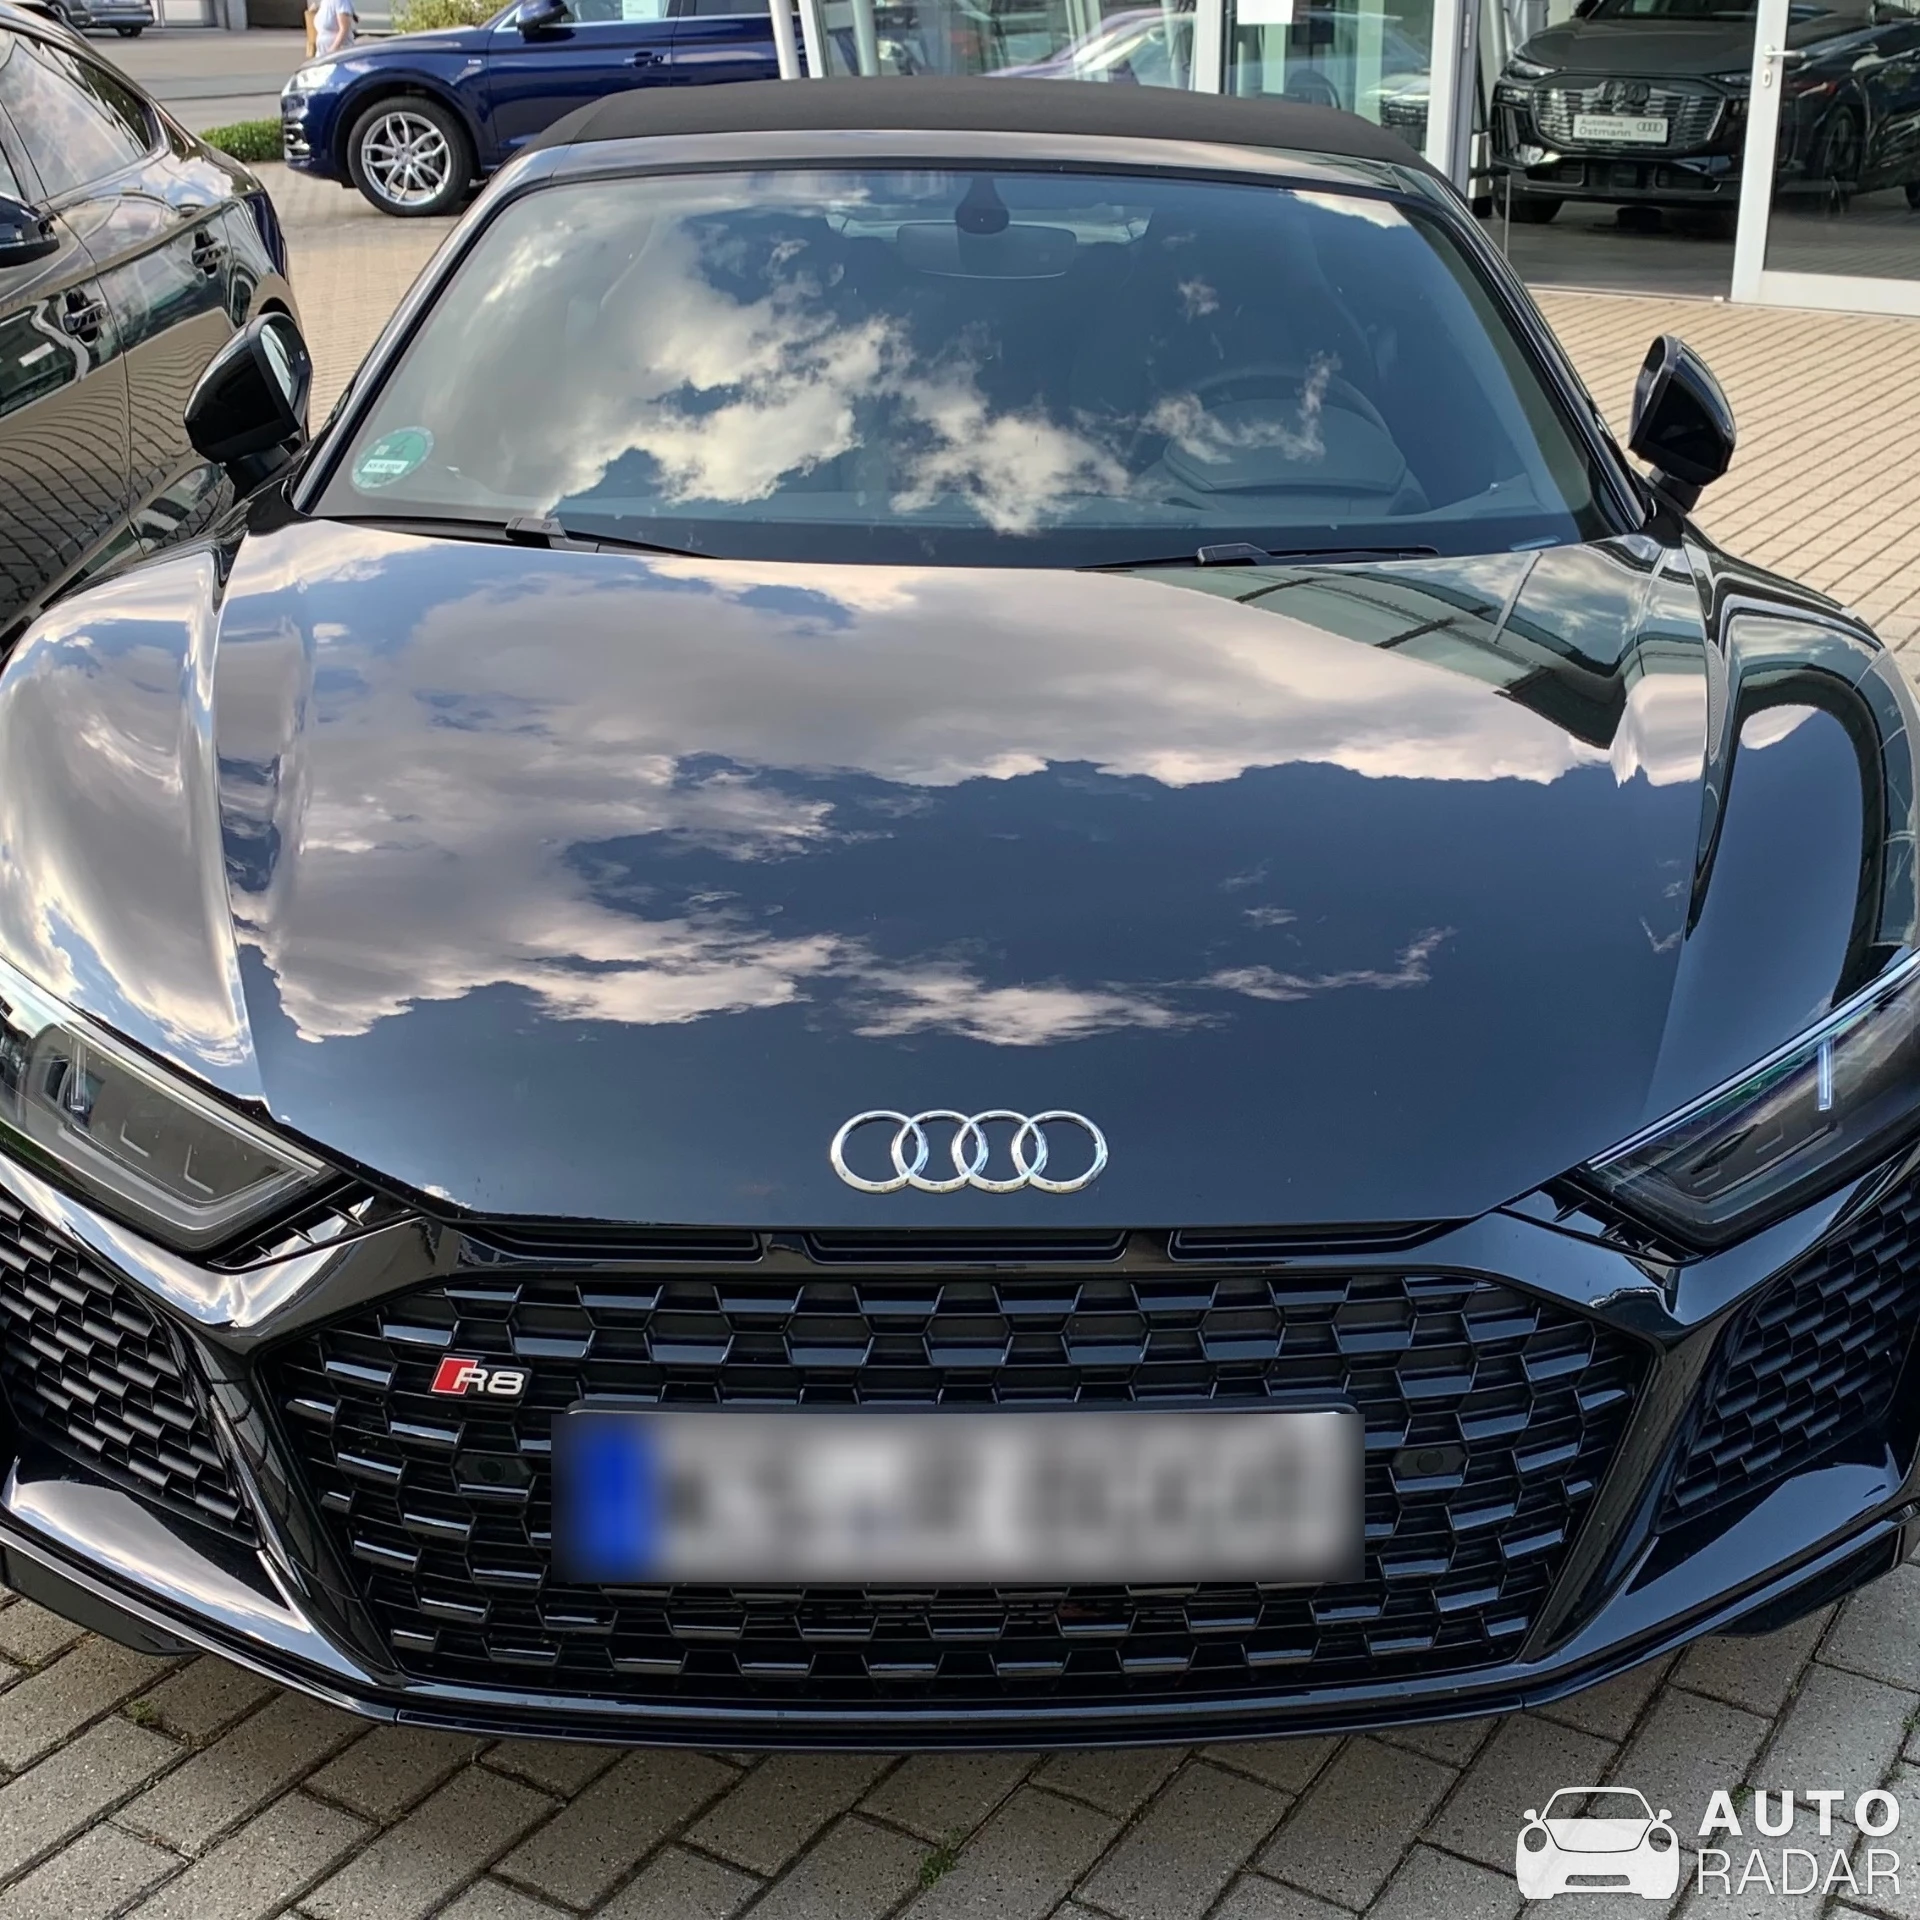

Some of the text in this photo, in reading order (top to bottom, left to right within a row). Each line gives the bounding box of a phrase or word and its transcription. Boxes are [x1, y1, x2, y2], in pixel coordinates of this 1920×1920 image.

[1581, 118, 1624, 127] Autohaus
[1579, 126, 1631, 137] Ostmann
[451, 1367, 525, 1395] R8
